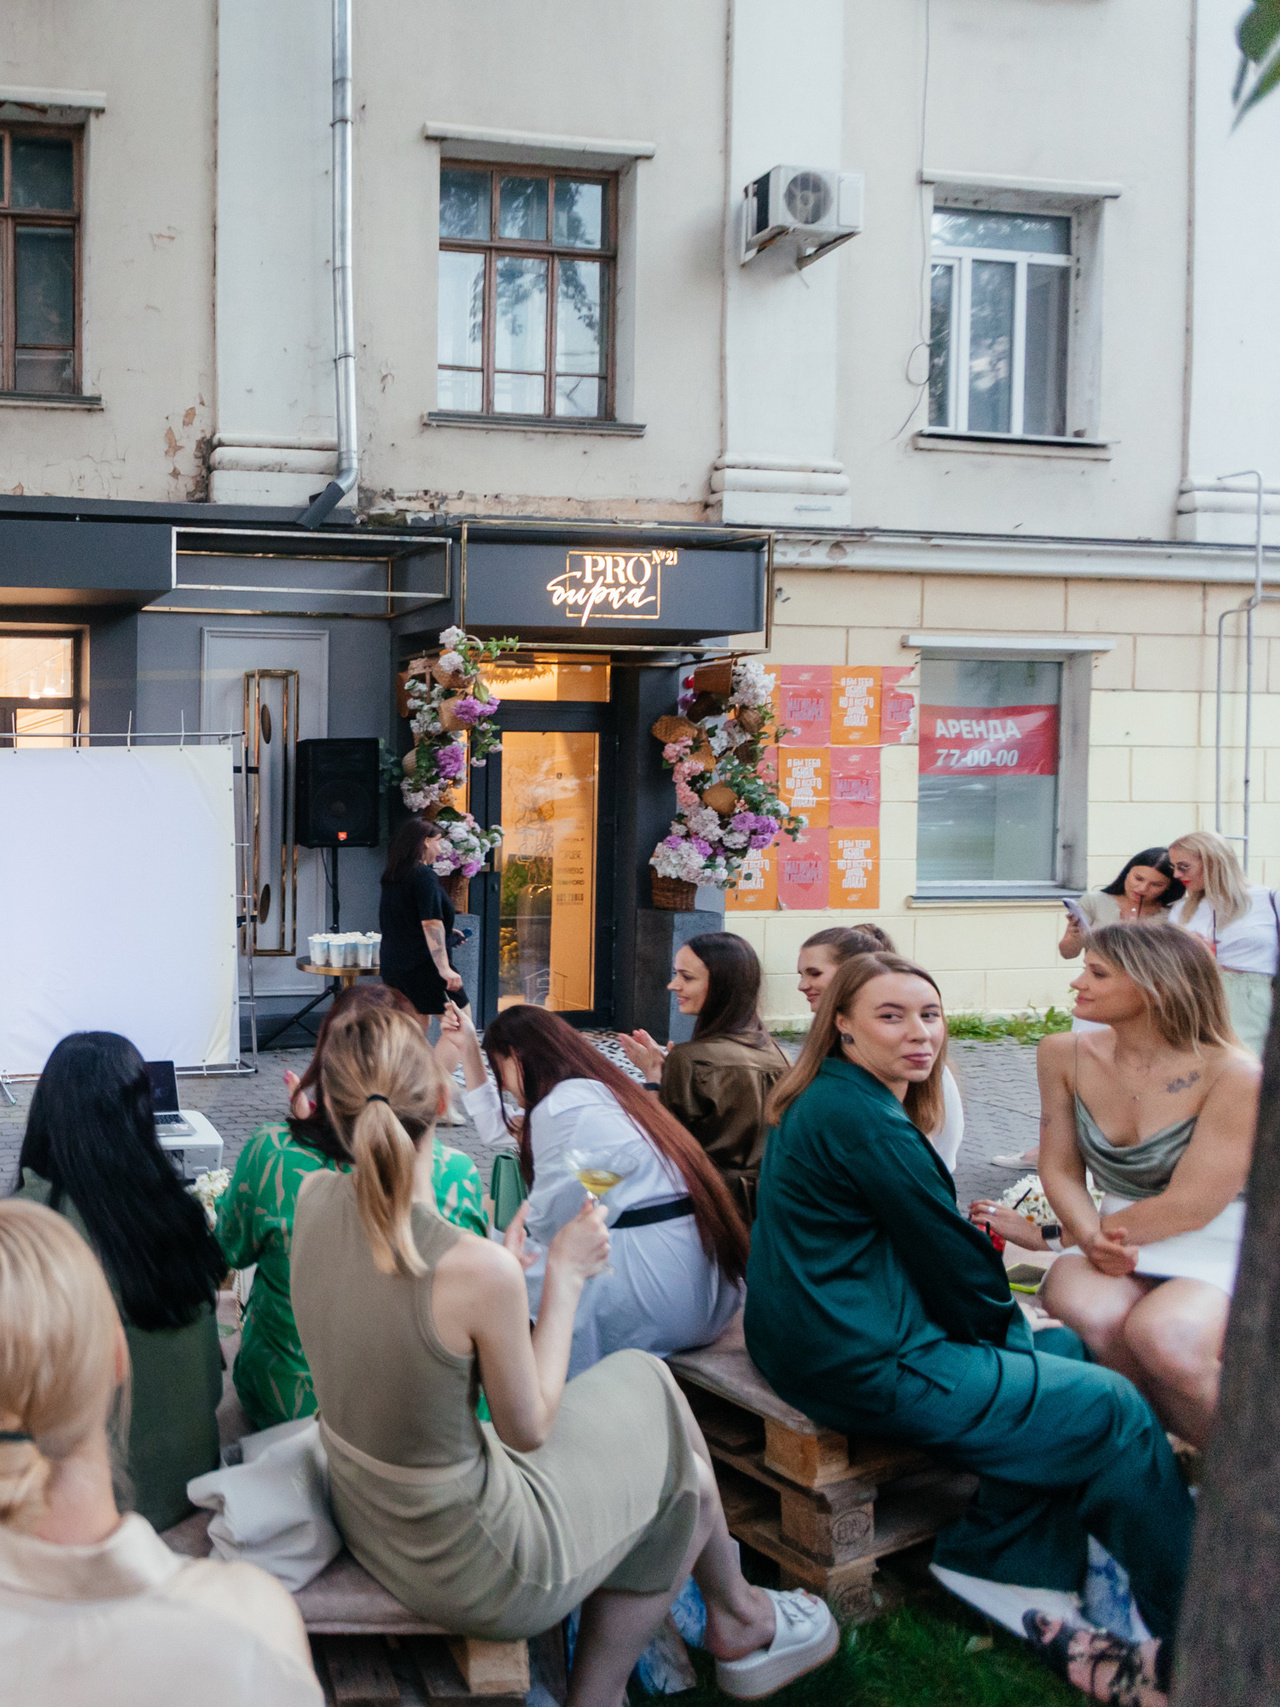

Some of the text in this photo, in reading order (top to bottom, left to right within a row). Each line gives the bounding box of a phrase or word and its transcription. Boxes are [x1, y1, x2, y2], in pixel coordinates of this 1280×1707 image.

[583, 555, 652, 585] PRO
[935, 719, 1022, 742] АРЕНДА
[936, 749, 1019, 767] 77-00-00
